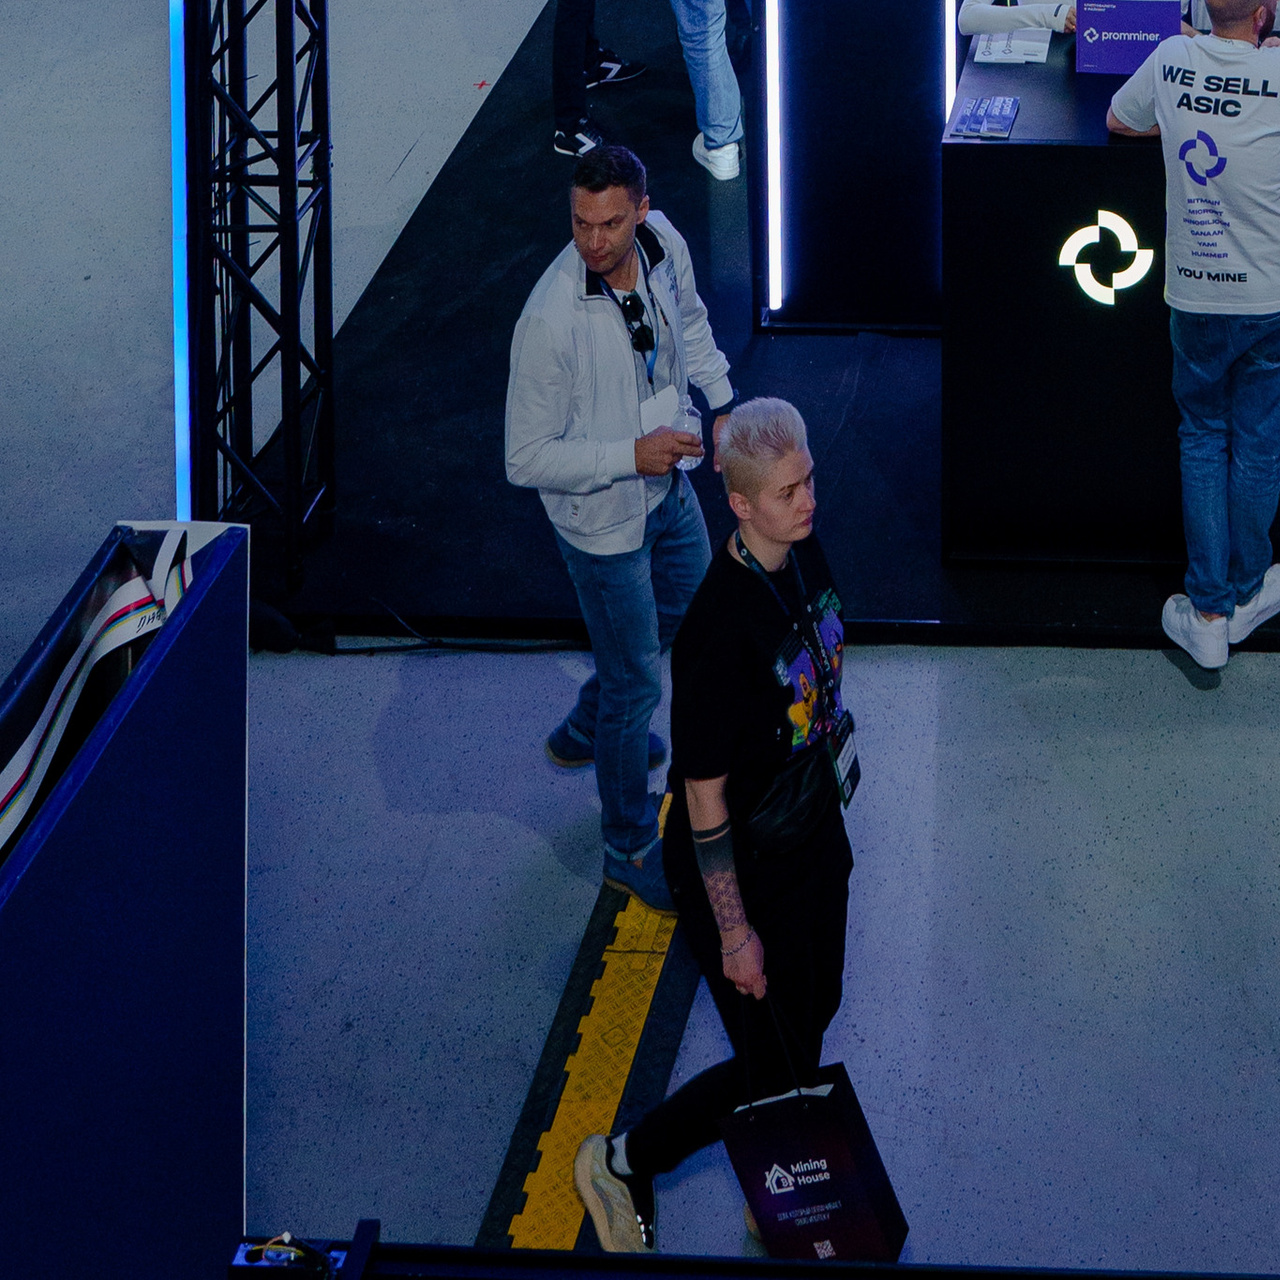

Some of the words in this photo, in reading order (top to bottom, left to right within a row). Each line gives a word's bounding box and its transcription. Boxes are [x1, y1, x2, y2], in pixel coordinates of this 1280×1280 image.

[1102, 30, 1160, 42] promminer
[1162, 64, 1196, 88] WE
[1203, 75, 1278, 98] SELL
[1177, 92, 1242, 117] ASIC
[1177, 265, 1203, 280] YOU
[1207, 271, 1247, 283] MINE
[790, 1158, 828, 1175] Mining
[797, 1171, 831, 1186] House
